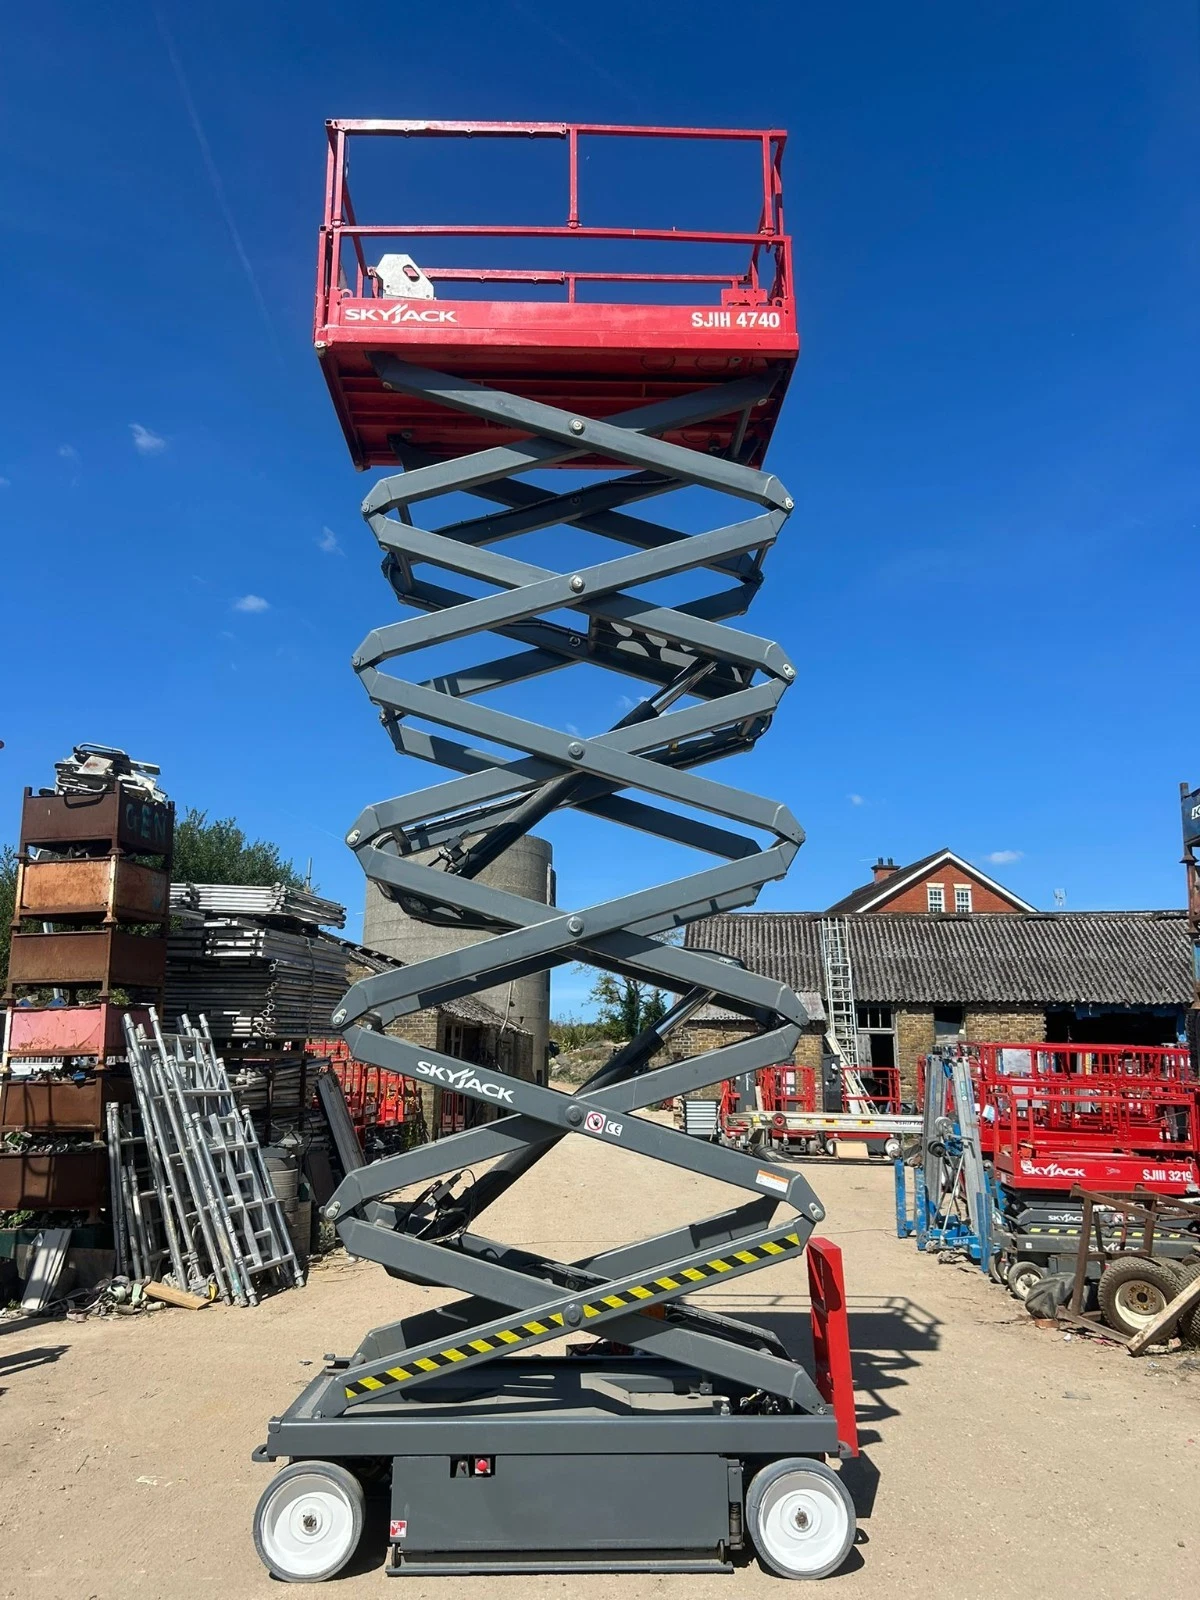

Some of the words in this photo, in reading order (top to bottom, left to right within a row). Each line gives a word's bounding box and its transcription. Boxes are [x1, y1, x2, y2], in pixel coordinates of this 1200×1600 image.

[344, 303, 458, 325] SKYJACK
[736, 311, 780, 328] 4740
[416, 1060, 514, 1104] SKYJACK
[607, 1122, 622, 1135] CE
[1022, 1163, 1087, 1177] SKYJACK
[1048, 1213, 1083, 1223] SKYJAC
